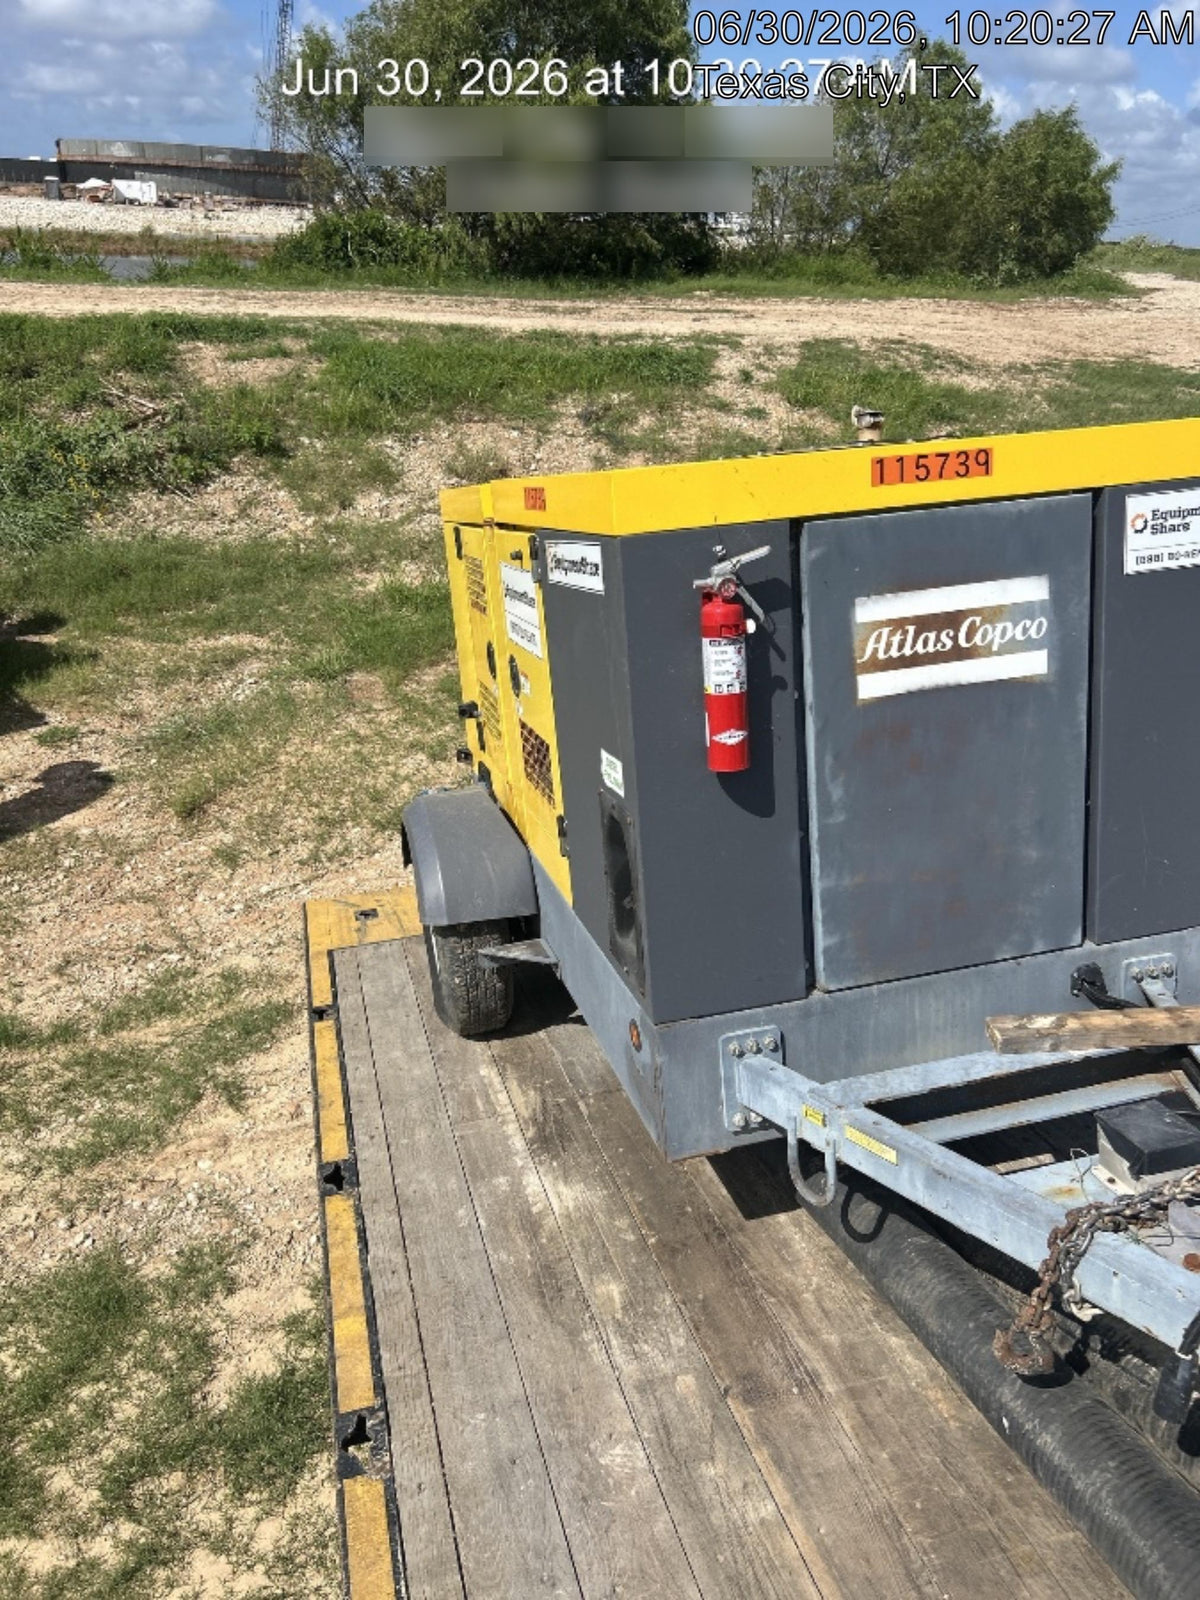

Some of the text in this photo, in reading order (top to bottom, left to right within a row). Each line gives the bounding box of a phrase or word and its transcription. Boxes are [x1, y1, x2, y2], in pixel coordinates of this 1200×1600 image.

[875, 449, 991, 485] 115739
[1150, 521, 1190, 535] Share
[857, 615, 1048, 664] Atlas Copco
